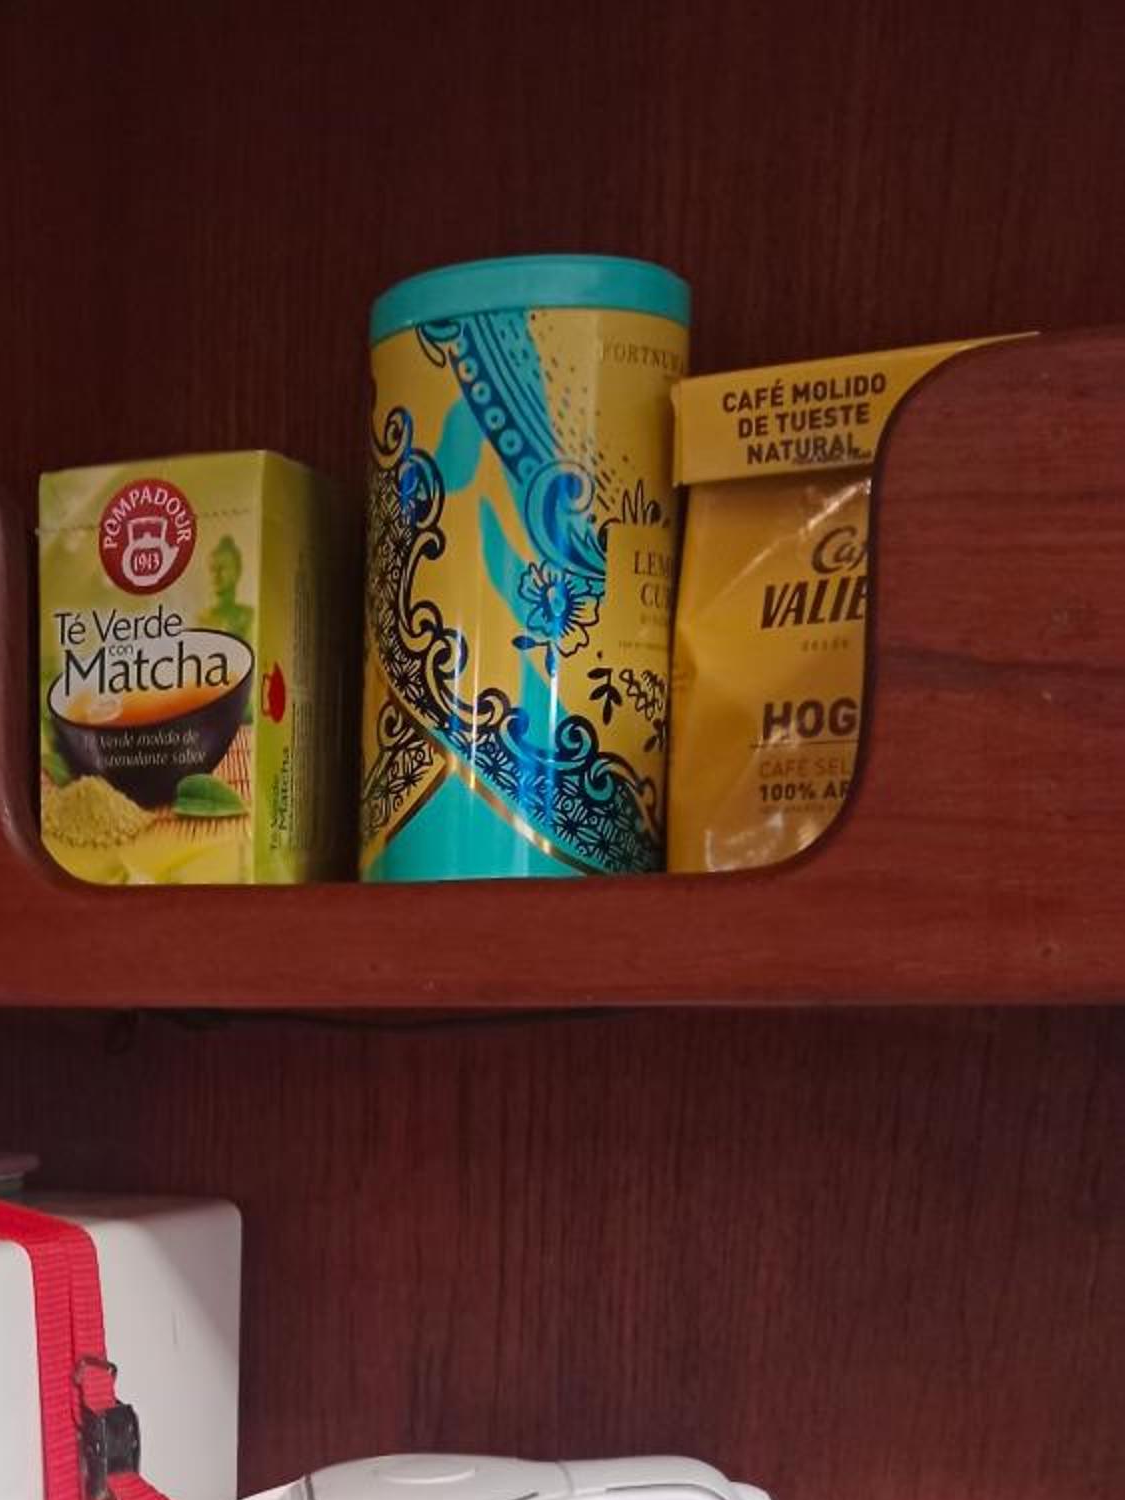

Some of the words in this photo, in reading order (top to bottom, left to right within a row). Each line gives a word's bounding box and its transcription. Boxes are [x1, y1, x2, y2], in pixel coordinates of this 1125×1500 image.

[722, 379, 784, 413] CAFÉ
[792, 373, 886, 404] MOLIDO
[738, 416, 768, 438] DE
[776, 403, 869, 433] TUESTE
[747, 433, 854, 464] NATURAL
[103, 485, 192, 549] POMPADOUR
[134, 551, 160, 572] 1913
[54, 613, 86, 646] Té
[92, 604, 182, 642] Verde
[65, 640, 229, 697] Matcha
[108, 644, 133, 657] con
[762, 697, 858, 740] HOG
[759, 780, 816, 803] 100%
